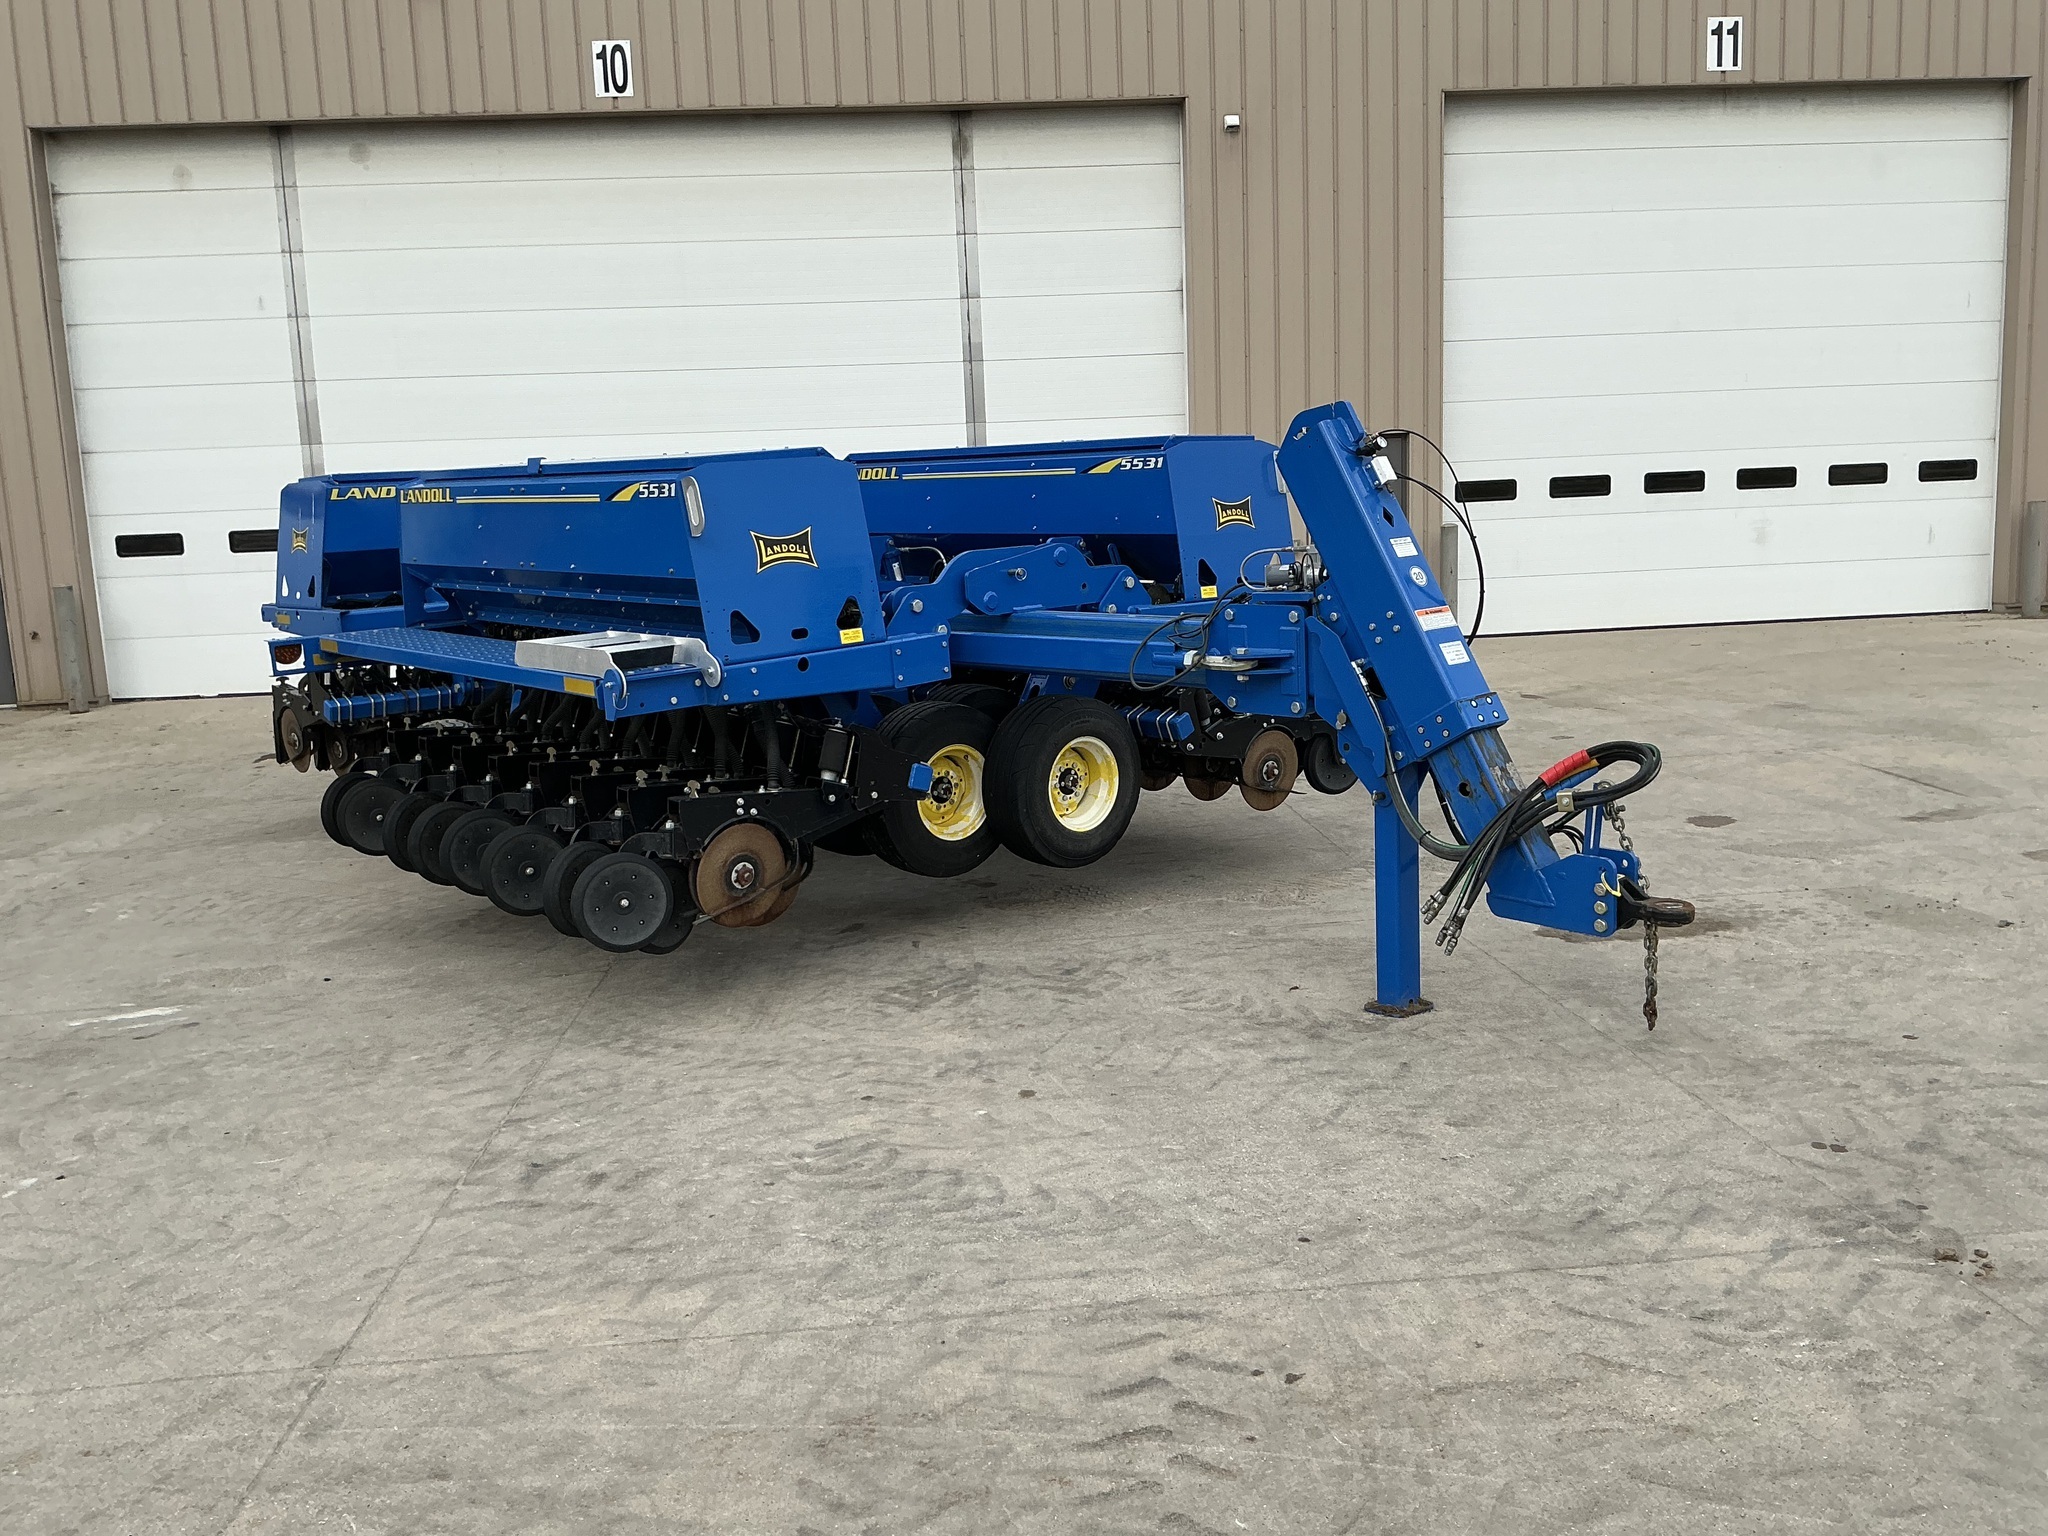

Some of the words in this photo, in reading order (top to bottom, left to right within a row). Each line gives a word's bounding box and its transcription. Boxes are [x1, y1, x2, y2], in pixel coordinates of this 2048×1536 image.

[1711, 20, 1739, 67] 11
[596, 44, 628, 93] 10
[1120, 457, 1164, 470] 5531
[330, 486, 397, 500] LAND
[400, 488, 454, 503] LANDOLL
[639, 483, 676, 497] 5531
[1217, 504, 1250, 523] LANDOLL
[759, 539, 810, 563] LANDOLL
[1413, 571, 1424, 580] 20
